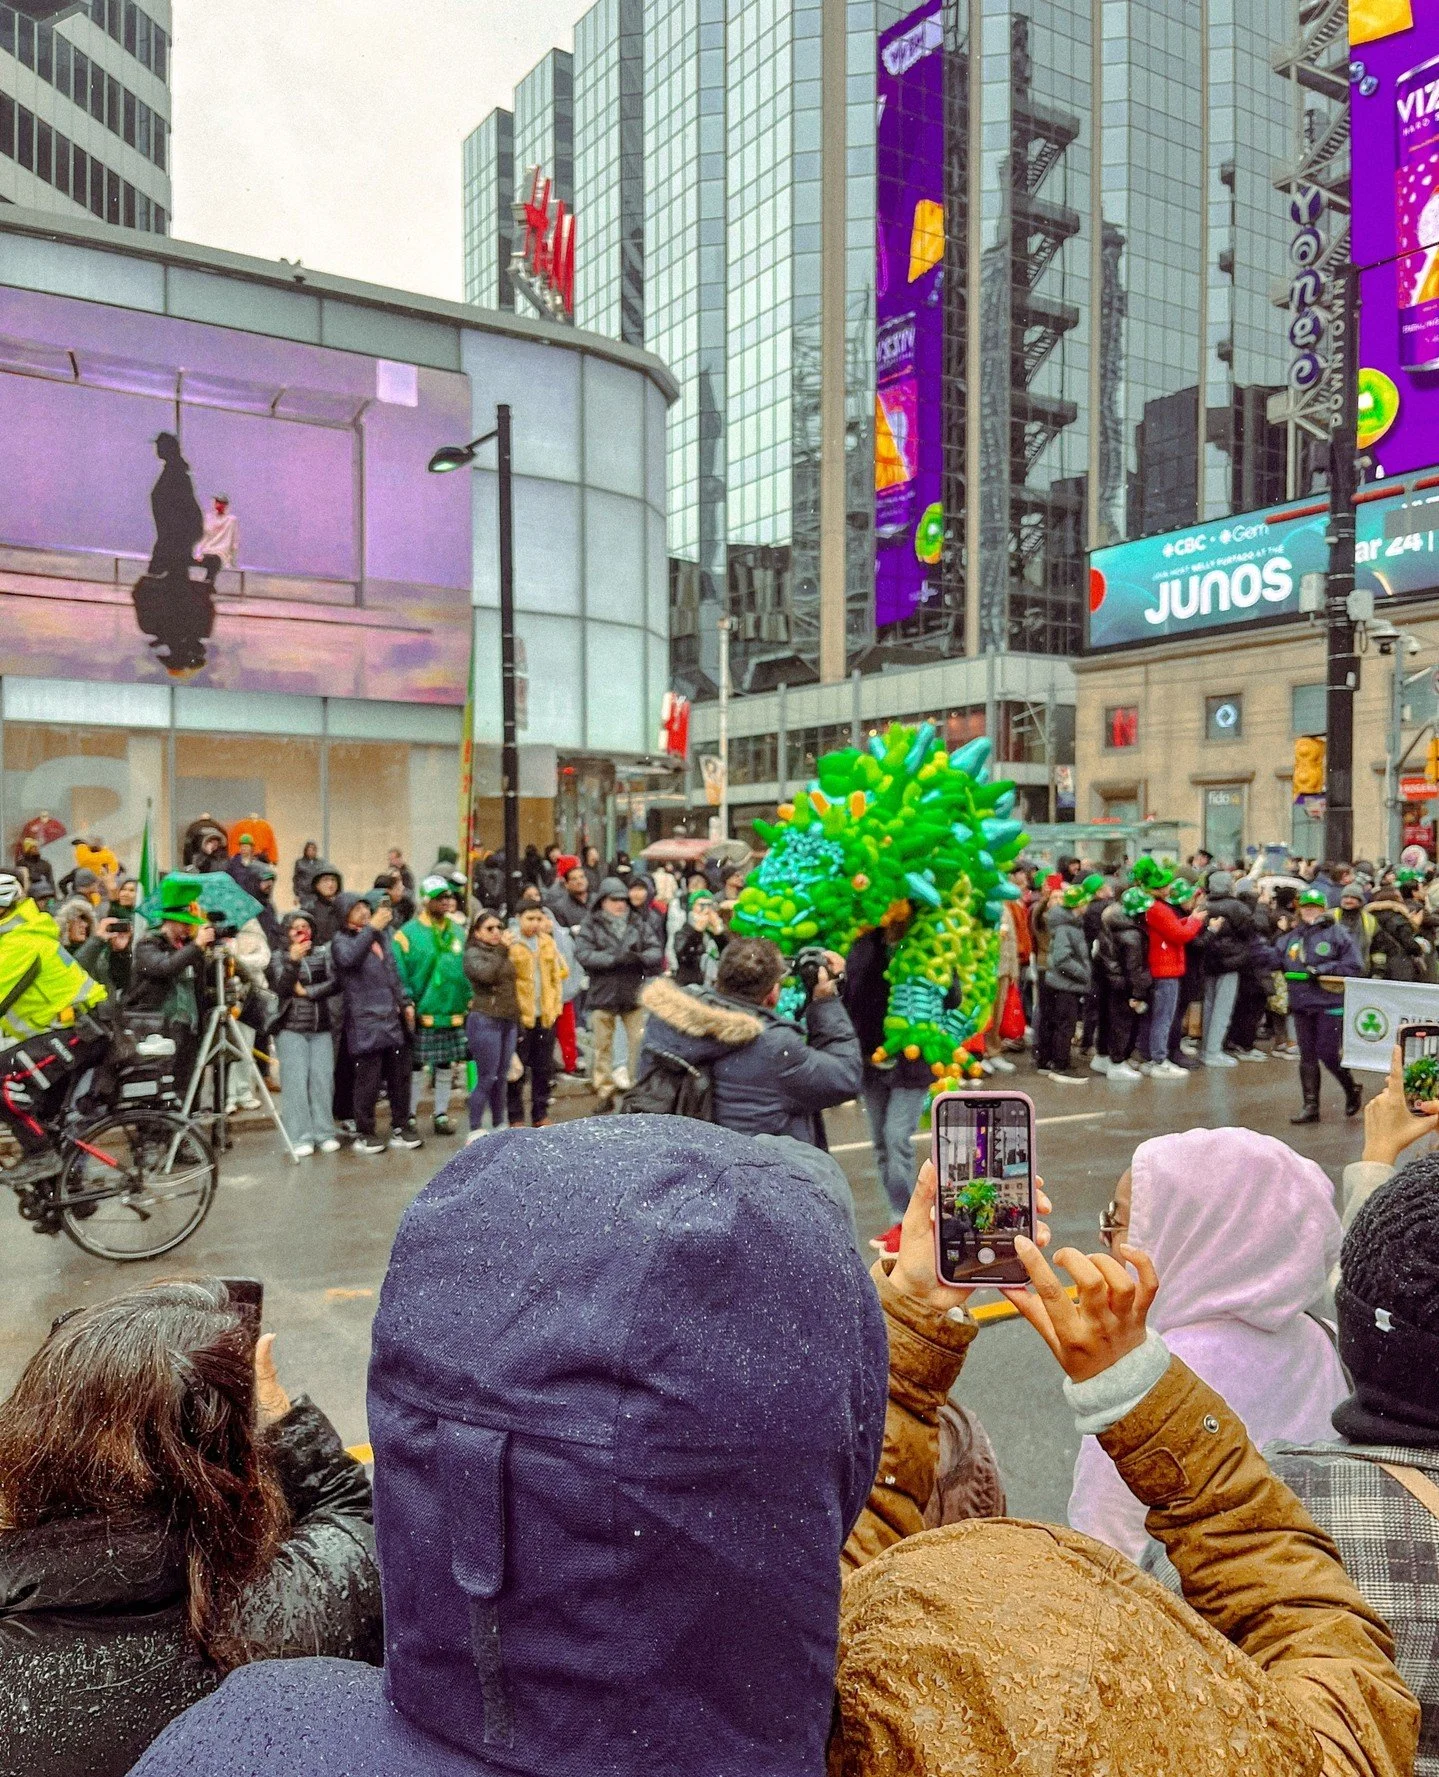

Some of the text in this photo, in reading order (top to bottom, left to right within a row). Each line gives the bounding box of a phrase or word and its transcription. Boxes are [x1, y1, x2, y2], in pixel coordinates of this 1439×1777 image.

[1173, 522, 1270, 556] CBC Gem
[1384, 532, 1424, 558] 24
